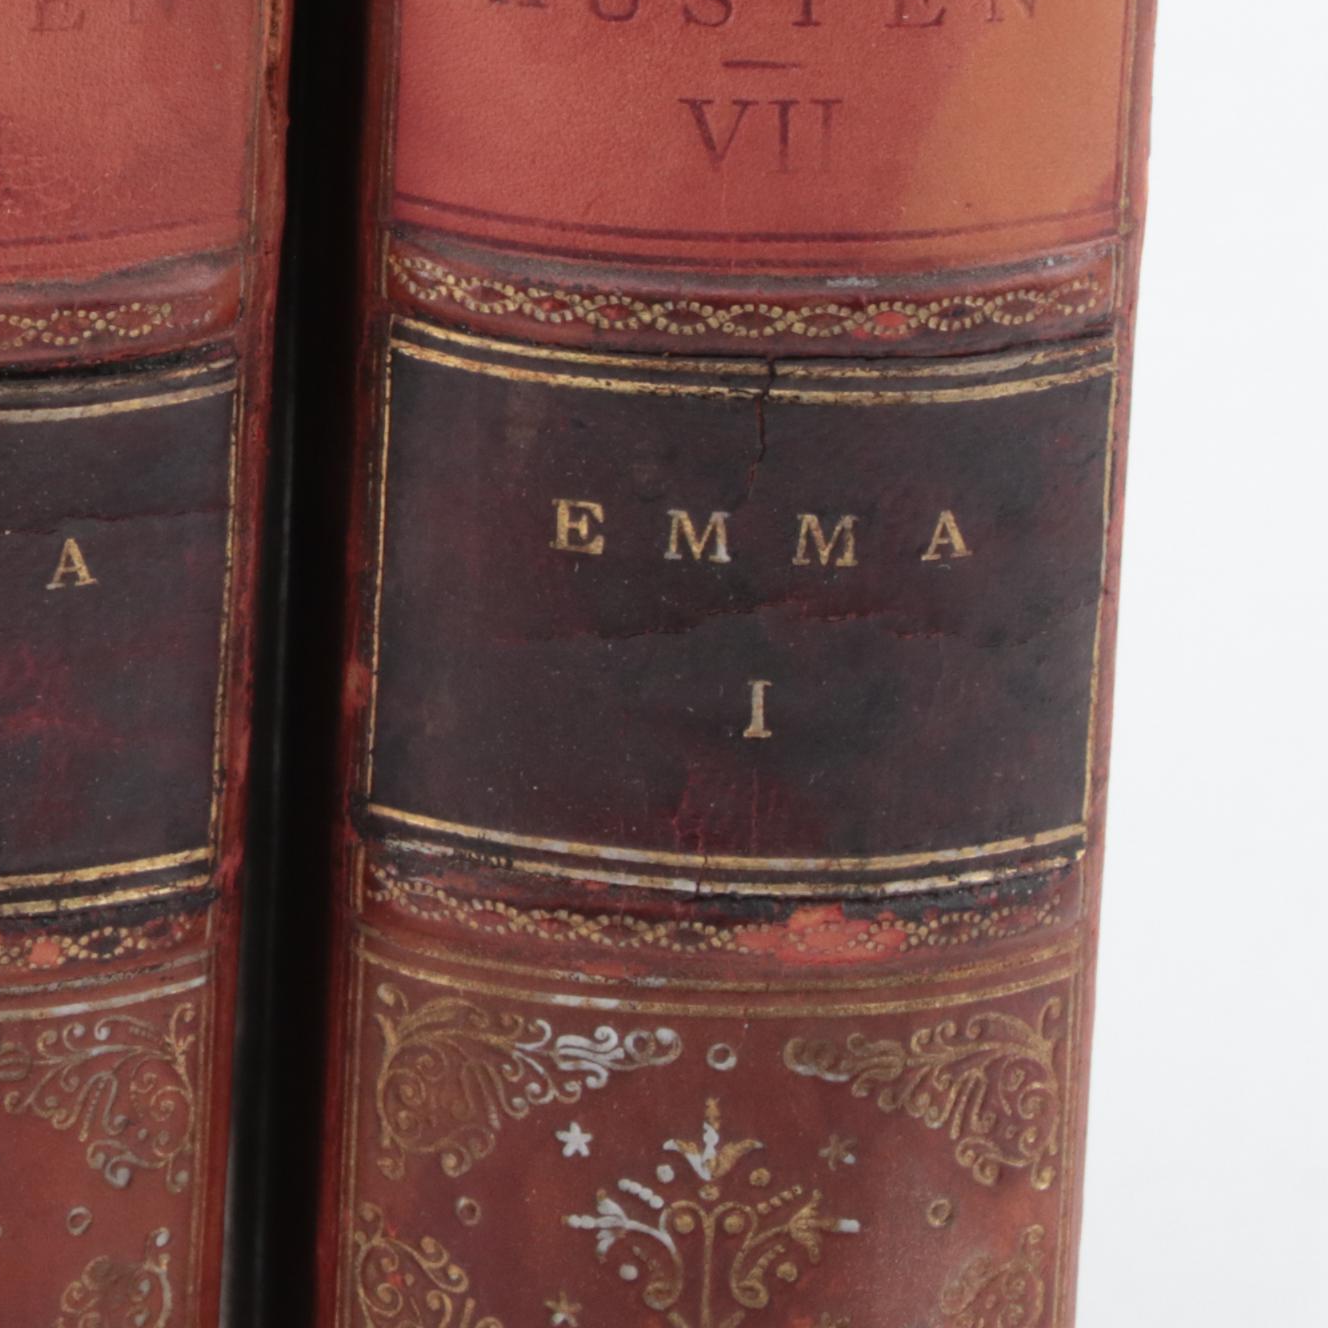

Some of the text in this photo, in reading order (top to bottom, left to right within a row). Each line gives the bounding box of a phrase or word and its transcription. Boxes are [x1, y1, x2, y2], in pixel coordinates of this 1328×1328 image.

[677, 96, 846, 176] VII
[548, 496, 975, 568] EMMA
[740, 677, 775, 741] I
